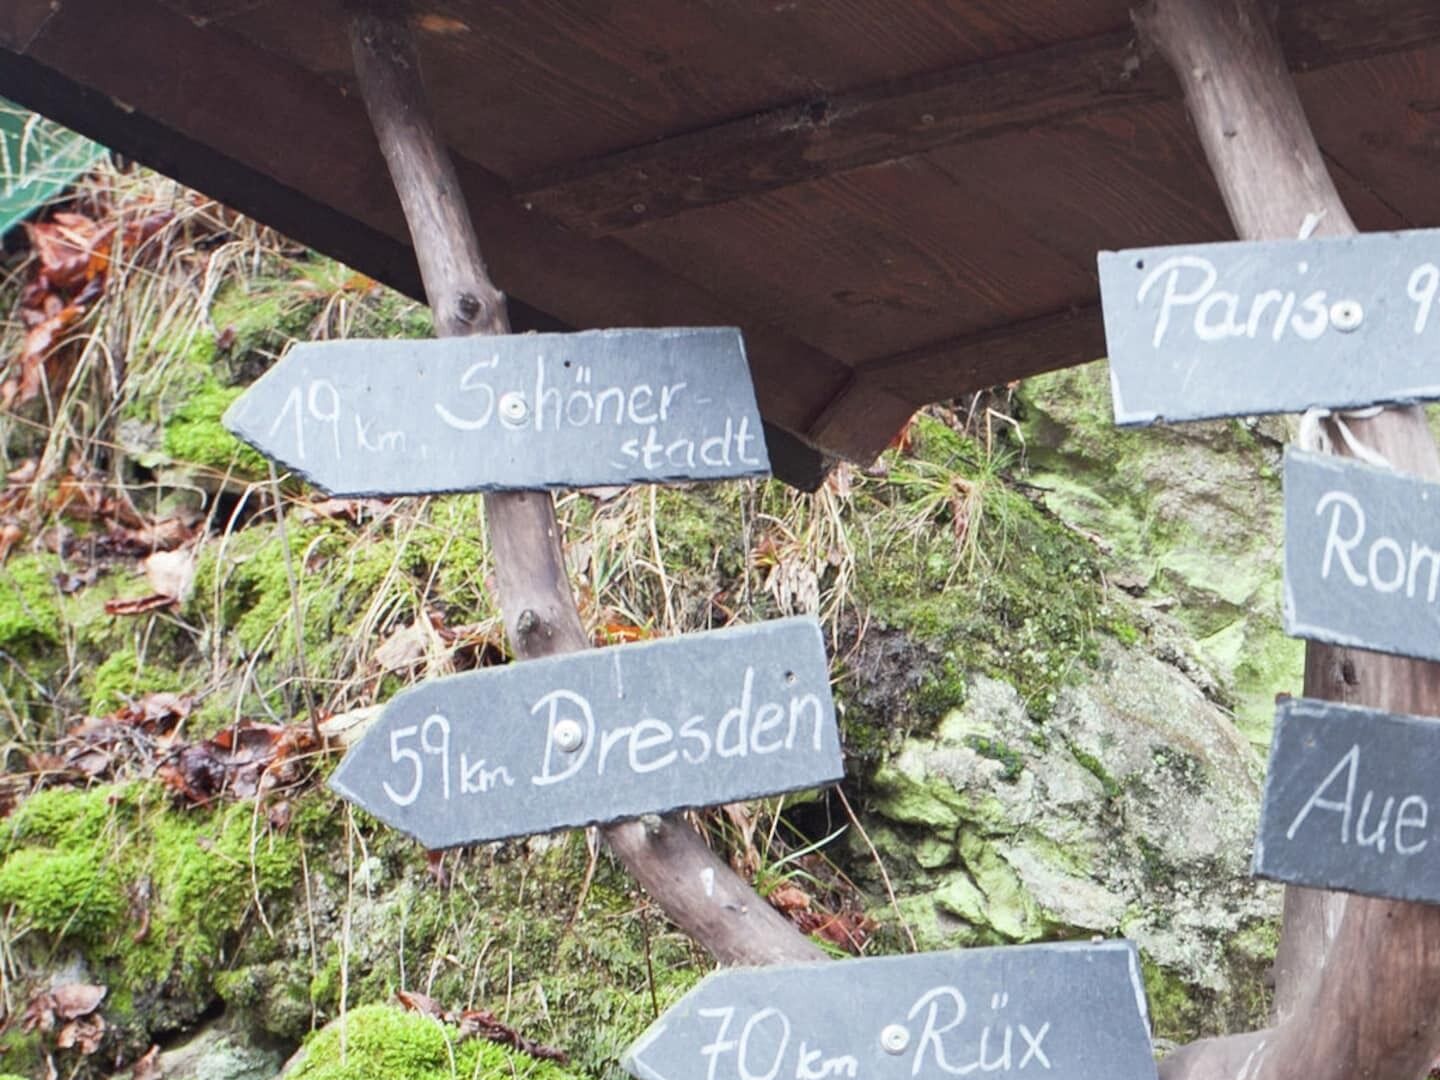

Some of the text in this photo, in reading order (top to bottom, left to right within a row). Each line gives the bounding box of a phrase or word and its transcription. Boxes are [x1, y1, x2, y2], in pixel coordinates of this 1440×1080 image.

[1137, 256, 1329, 347] Paris
[269, 378, 342, 461] 19
[611, 415, 760, 470] stadt
[383, 714, 451, 806] 59
[530, 666, 824, 787] Dresden
[1287, 743, 1429, 855] Aue
[906, 985, 1051, 1077] Rüx
